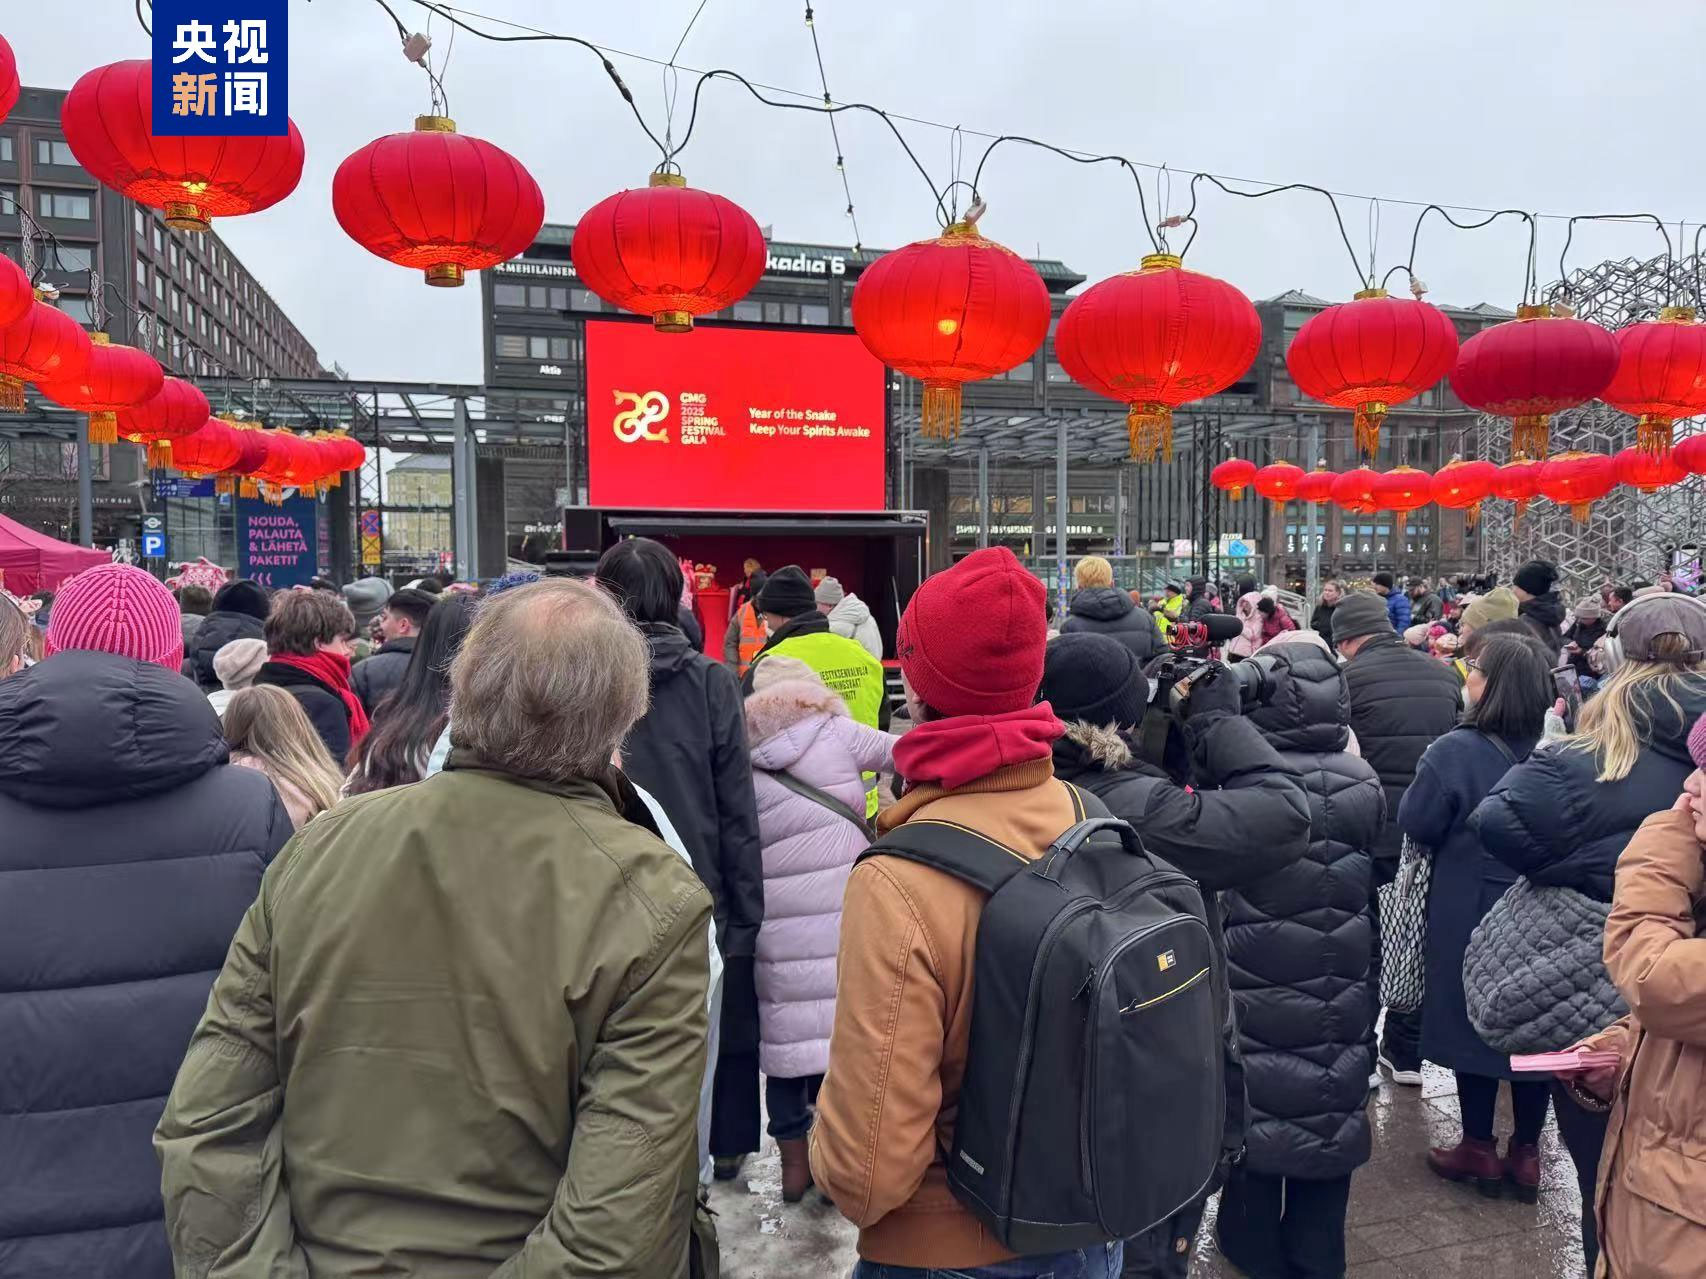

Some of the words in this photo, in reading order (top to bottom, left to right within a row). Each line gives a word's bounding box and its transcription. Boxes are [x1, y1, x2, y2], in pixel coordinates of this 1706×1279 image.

[765, 249, 826, 274] kadia
[830, 255, 846, 275] 6
[680, 392, 707, 404] CMG
[681, 406, 705, 416] 2025
[749, 407, 772, 419] Year
[774, 408, 786, 419] of
[786, 408, 804, 420] the
[805, 409, 837, 421] Snake
[681, 416, 719, 427] SPRING
[681, 426, 726, 436] FESTIVAL
[750, 423, 776, 437] Keep
[777, 424, 801, 435] Your
[802, 425, 836, 438] Spirits
[836, 426, 871, 438] Awake
[681, 435, 708, 445] GALA
[248, 516, 299, 528] NOUDA,
[248, 528, 304, 539] PALAUTA
[145, 536, 161, 555] P
[249, 542, 259, 552] &
[261, 540, 308, 553] LÄHETÄ
[249, 554, 299, 566] PAKETIT
